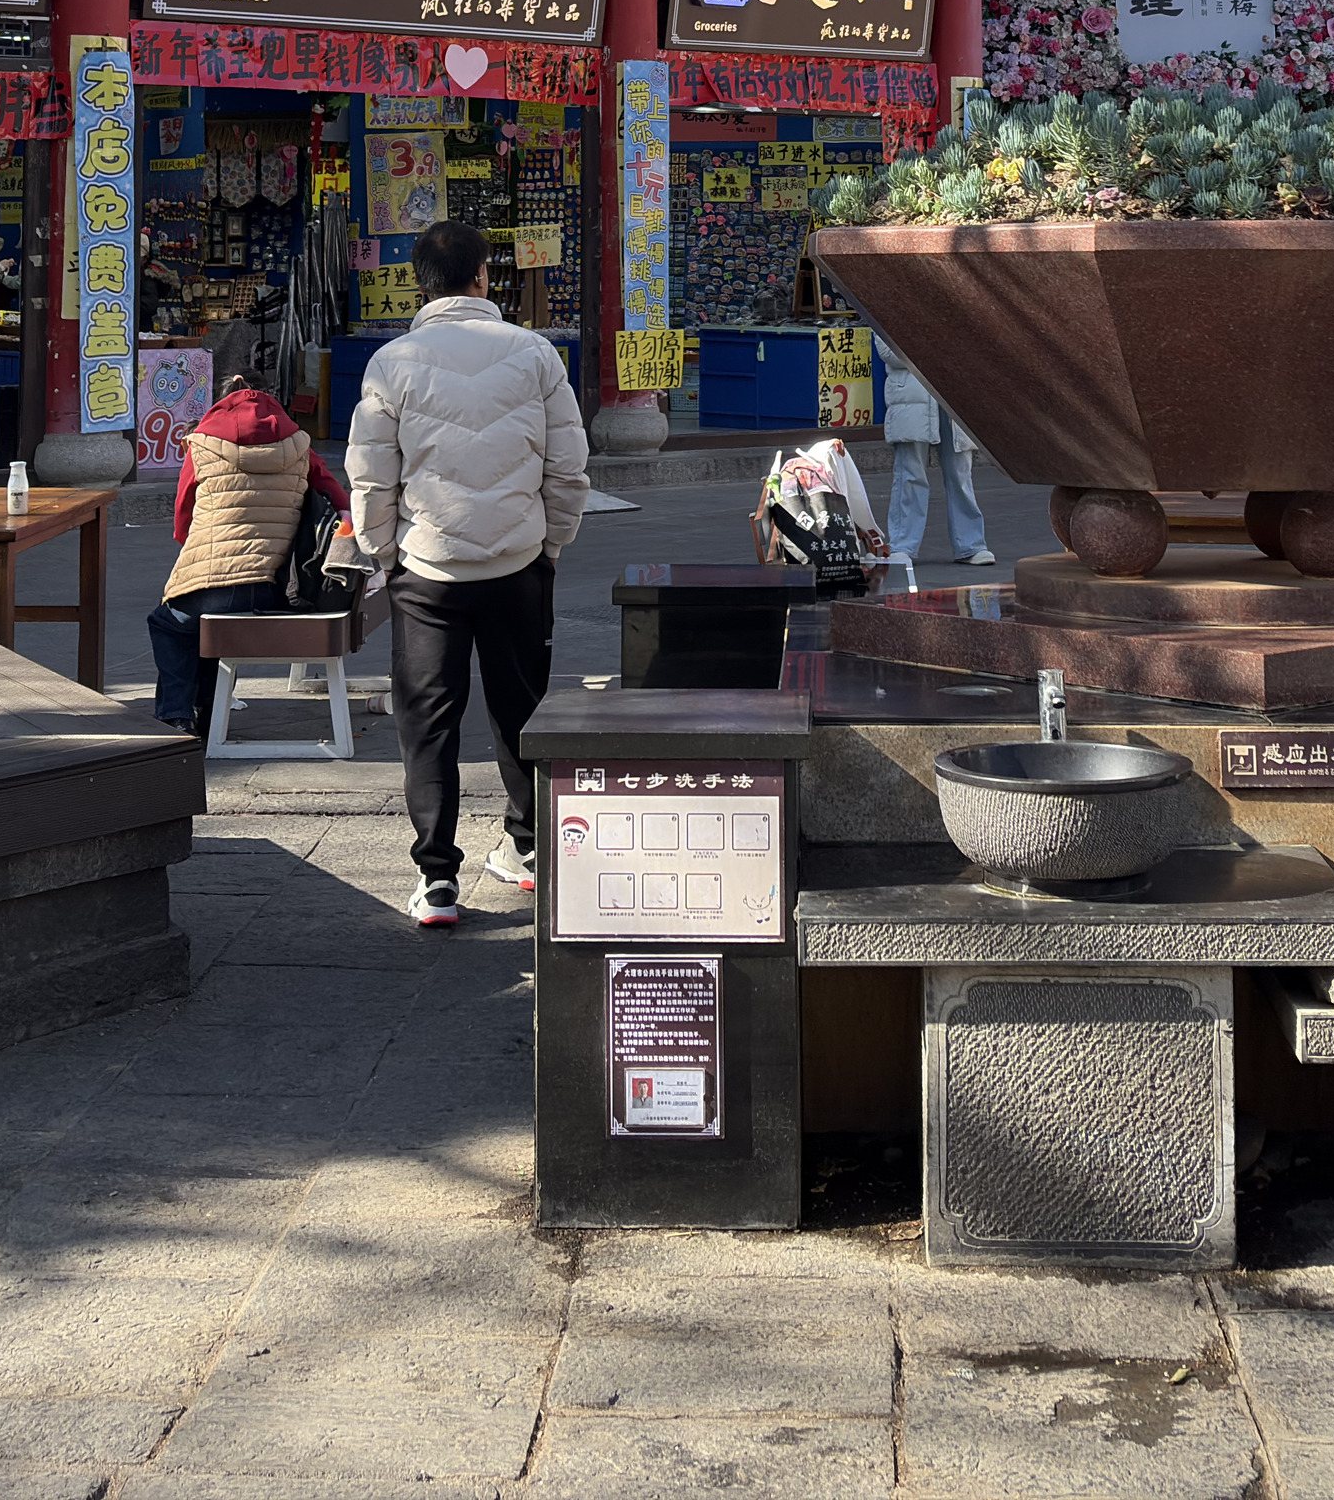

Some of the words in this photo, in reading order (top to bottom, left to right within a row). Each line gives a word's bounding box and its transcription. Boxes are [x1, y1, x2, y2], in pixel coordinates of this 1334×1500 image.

[1215, 0, 1224, 14] MEI
[694, 21, 738, 33] Groceries
[820, 18, 912, 43] 疯狂的杂货出品
[390, 139, 436, 177] 3.9
[759, 141, 822, 162] 脑子进水
[79, 63, 132, 420] 本店免费盖章
[360, 267, 418, 287] 脑子进
[619, 331, 683, 358] 请勿停
[821, 328, 855, 354] 大理
[621, 360, 681, 390] 车谢谢
[818, 355, 872, 380] 文创冰箱贴
[830, 384, 871, 428] 3.99
[617, 773, 754, 789] 七步洗手法
[1262, 767, 1288, 776] Induced
